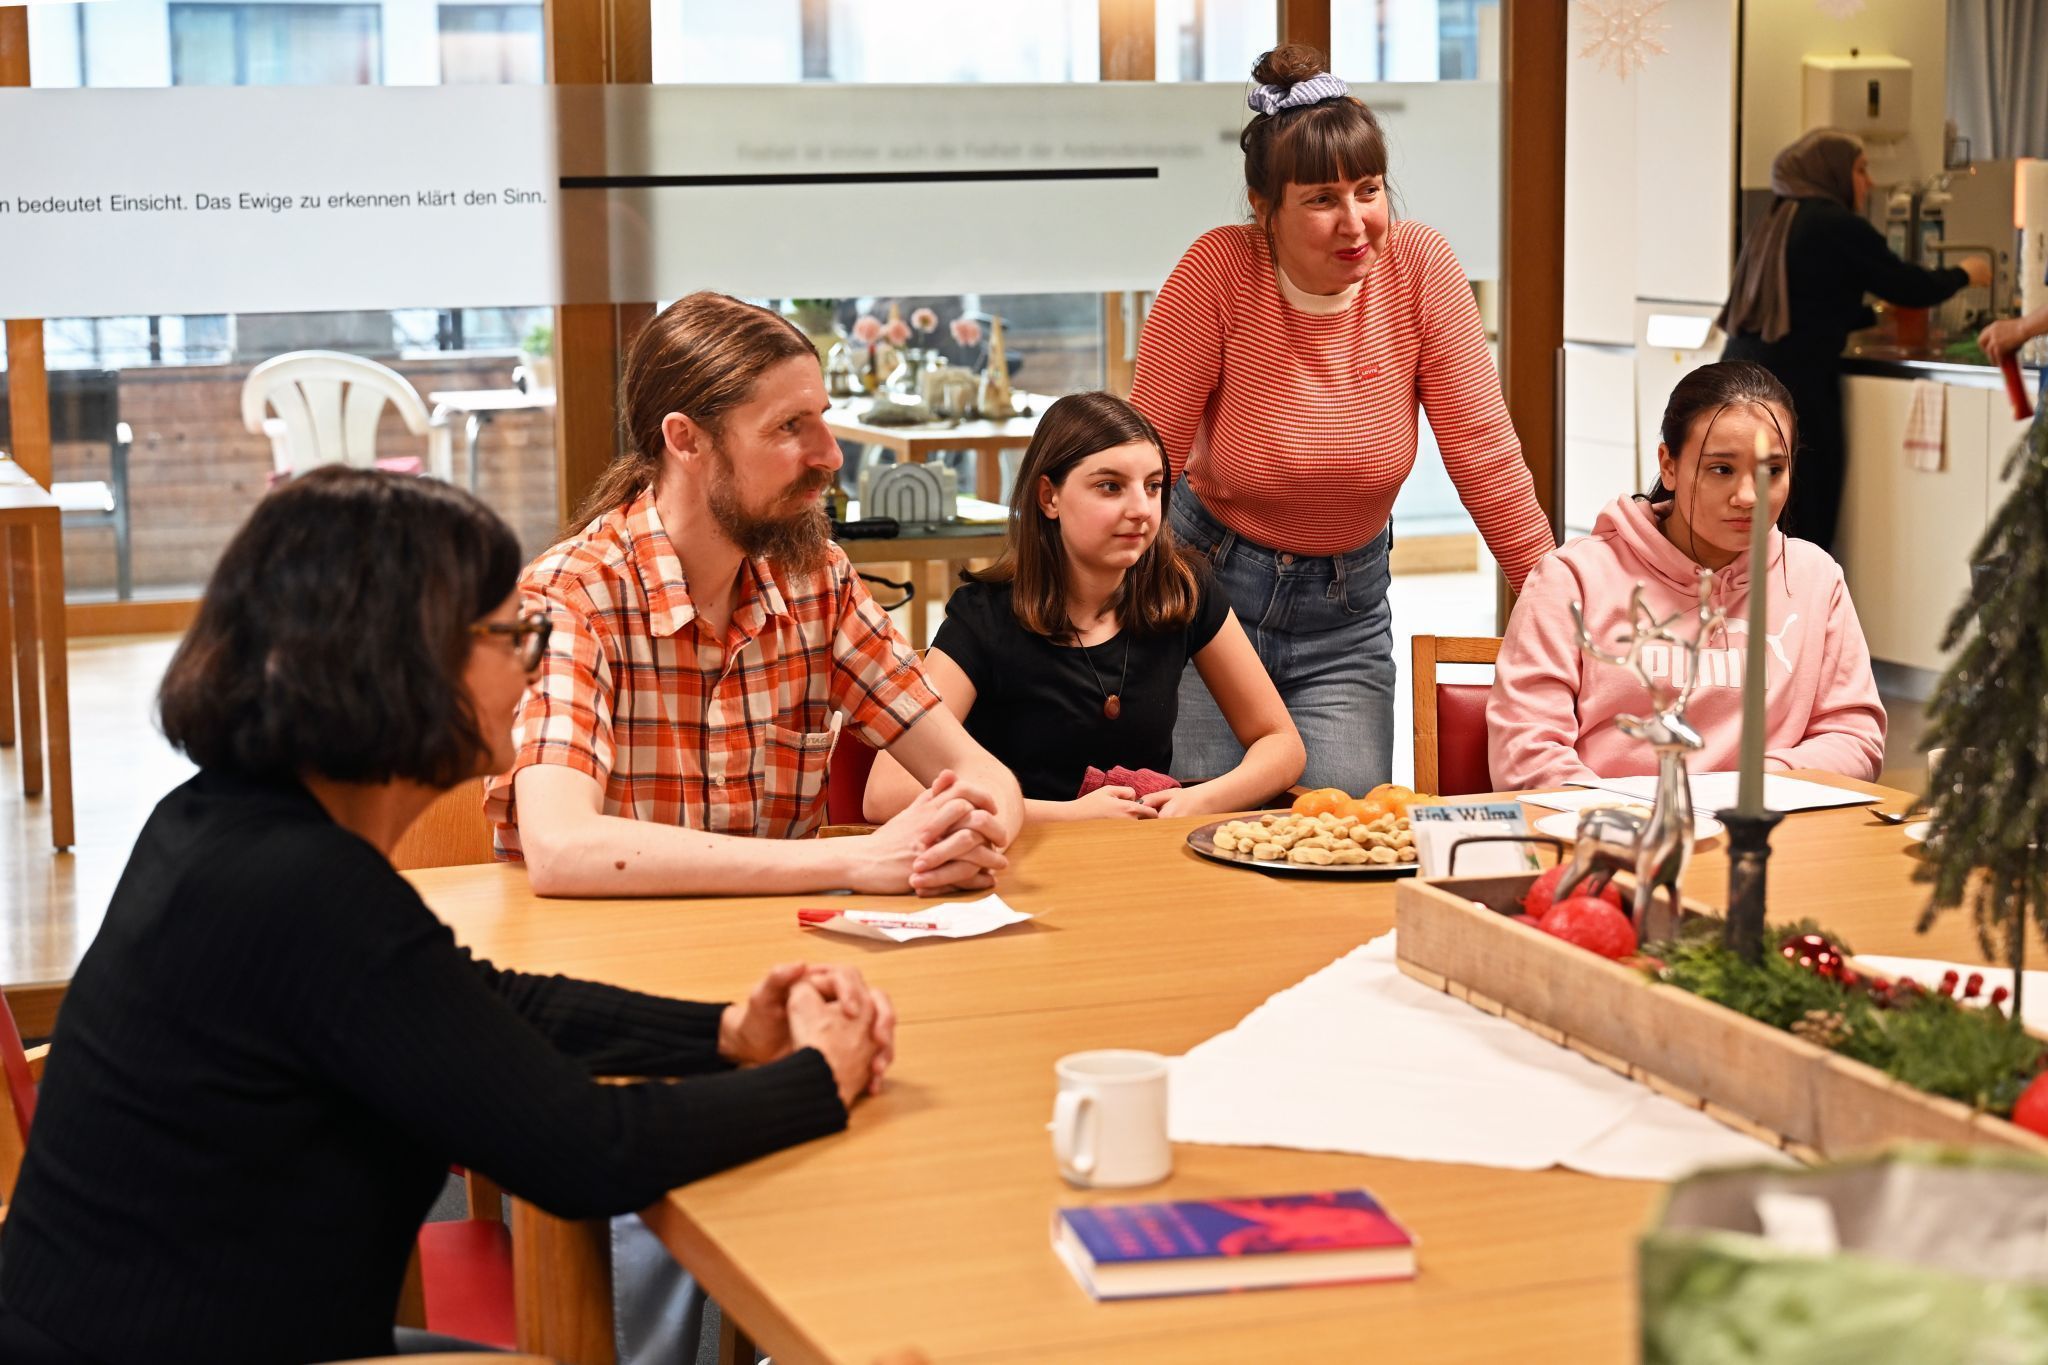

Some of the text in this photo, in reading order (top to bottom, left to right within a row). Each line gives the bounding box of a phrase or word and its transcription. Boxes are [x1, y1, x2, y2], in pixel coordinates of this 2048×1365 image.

[17, 195, 102, 214] bedeutet
[110, 193, 188, 212] Einsicht.
[196, 193, 231, 210] Das
[239, 192, 293, 211] Ewige
[300, 195, 321, 208] zu
[328, 192, 410, 208] erkennen
[417, 189, 456, 207] klärt
[463, 190, 497, 206] den
[503, 187, 547, 205] Sinn.
[1641, 645, 1768, 689] PUM
[1456, 805, 1518, 821] Wilma
